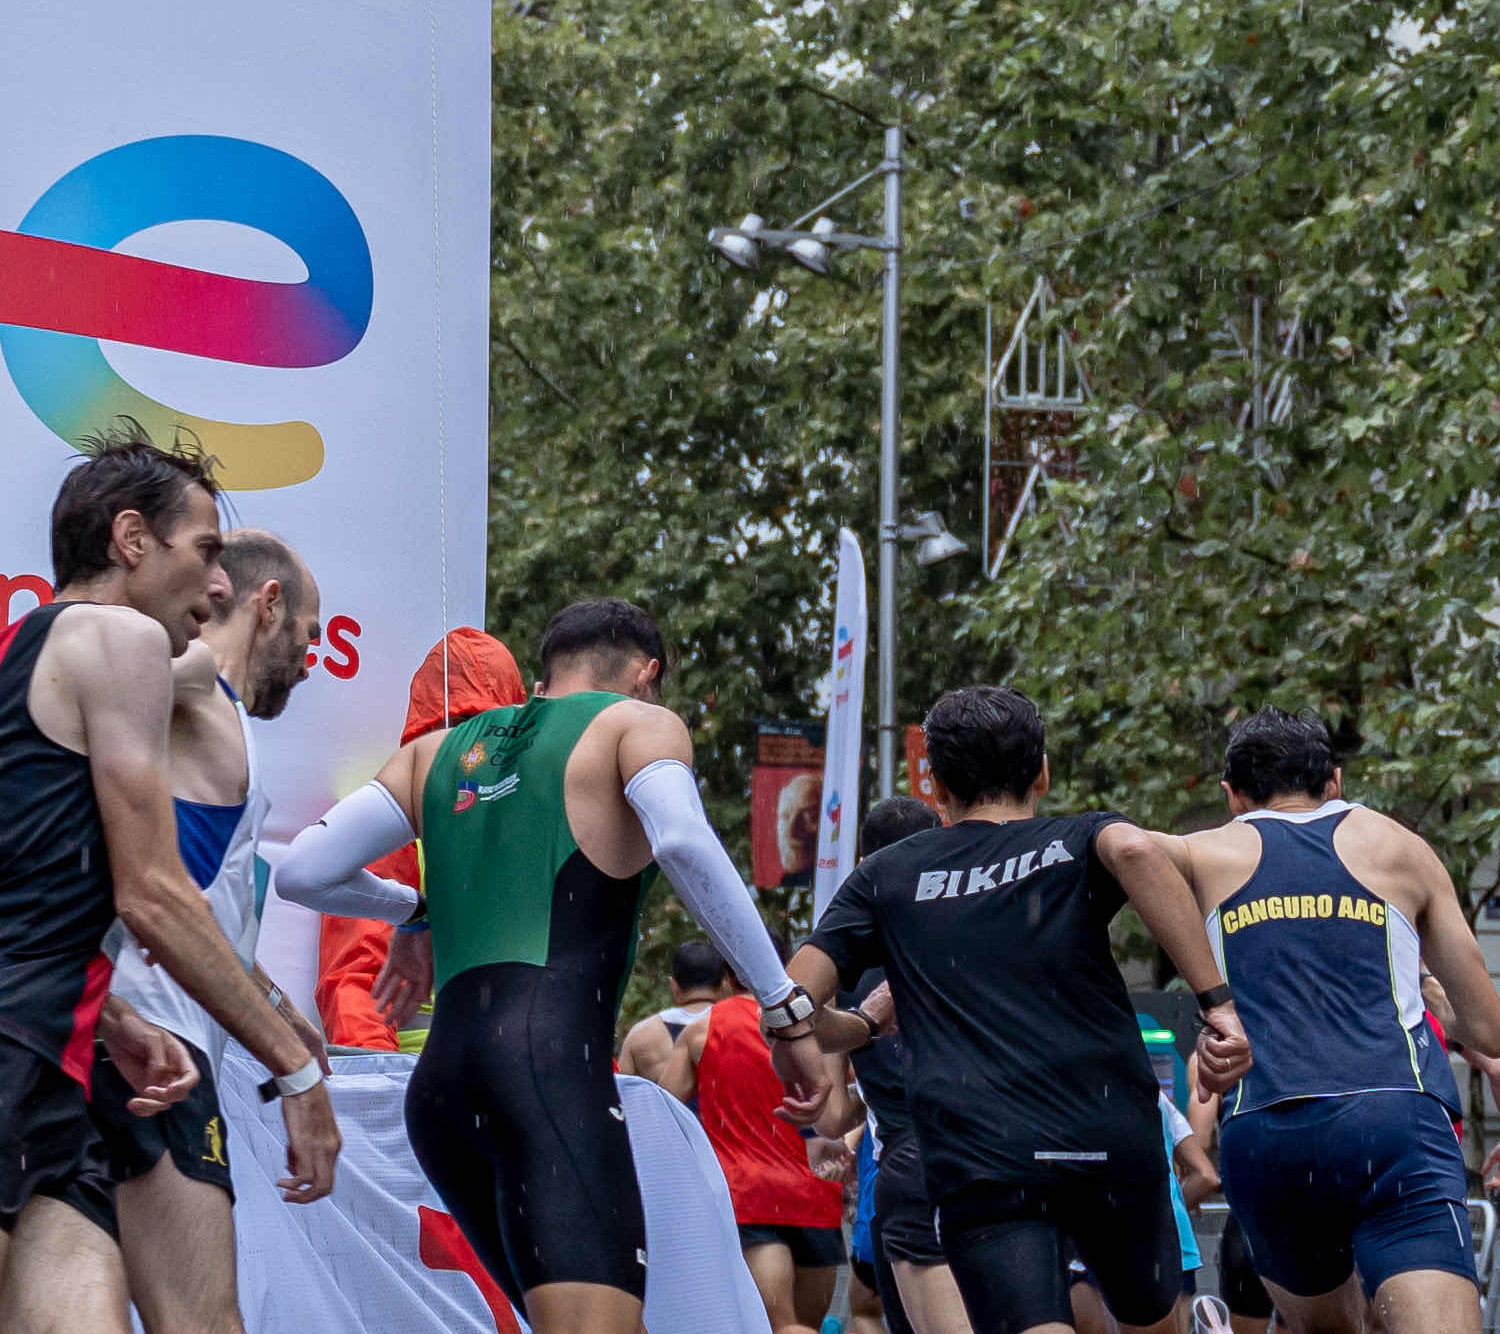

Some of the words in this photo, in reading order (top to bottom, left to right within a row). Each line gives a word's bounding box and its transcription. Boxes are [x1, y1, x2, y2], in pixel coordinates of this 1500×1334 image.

[914, 839, 1075, 902] BIKILA
[1222, 893, 1334, 935] CANGURO
[1337, 895, 1385, 927] AAC
